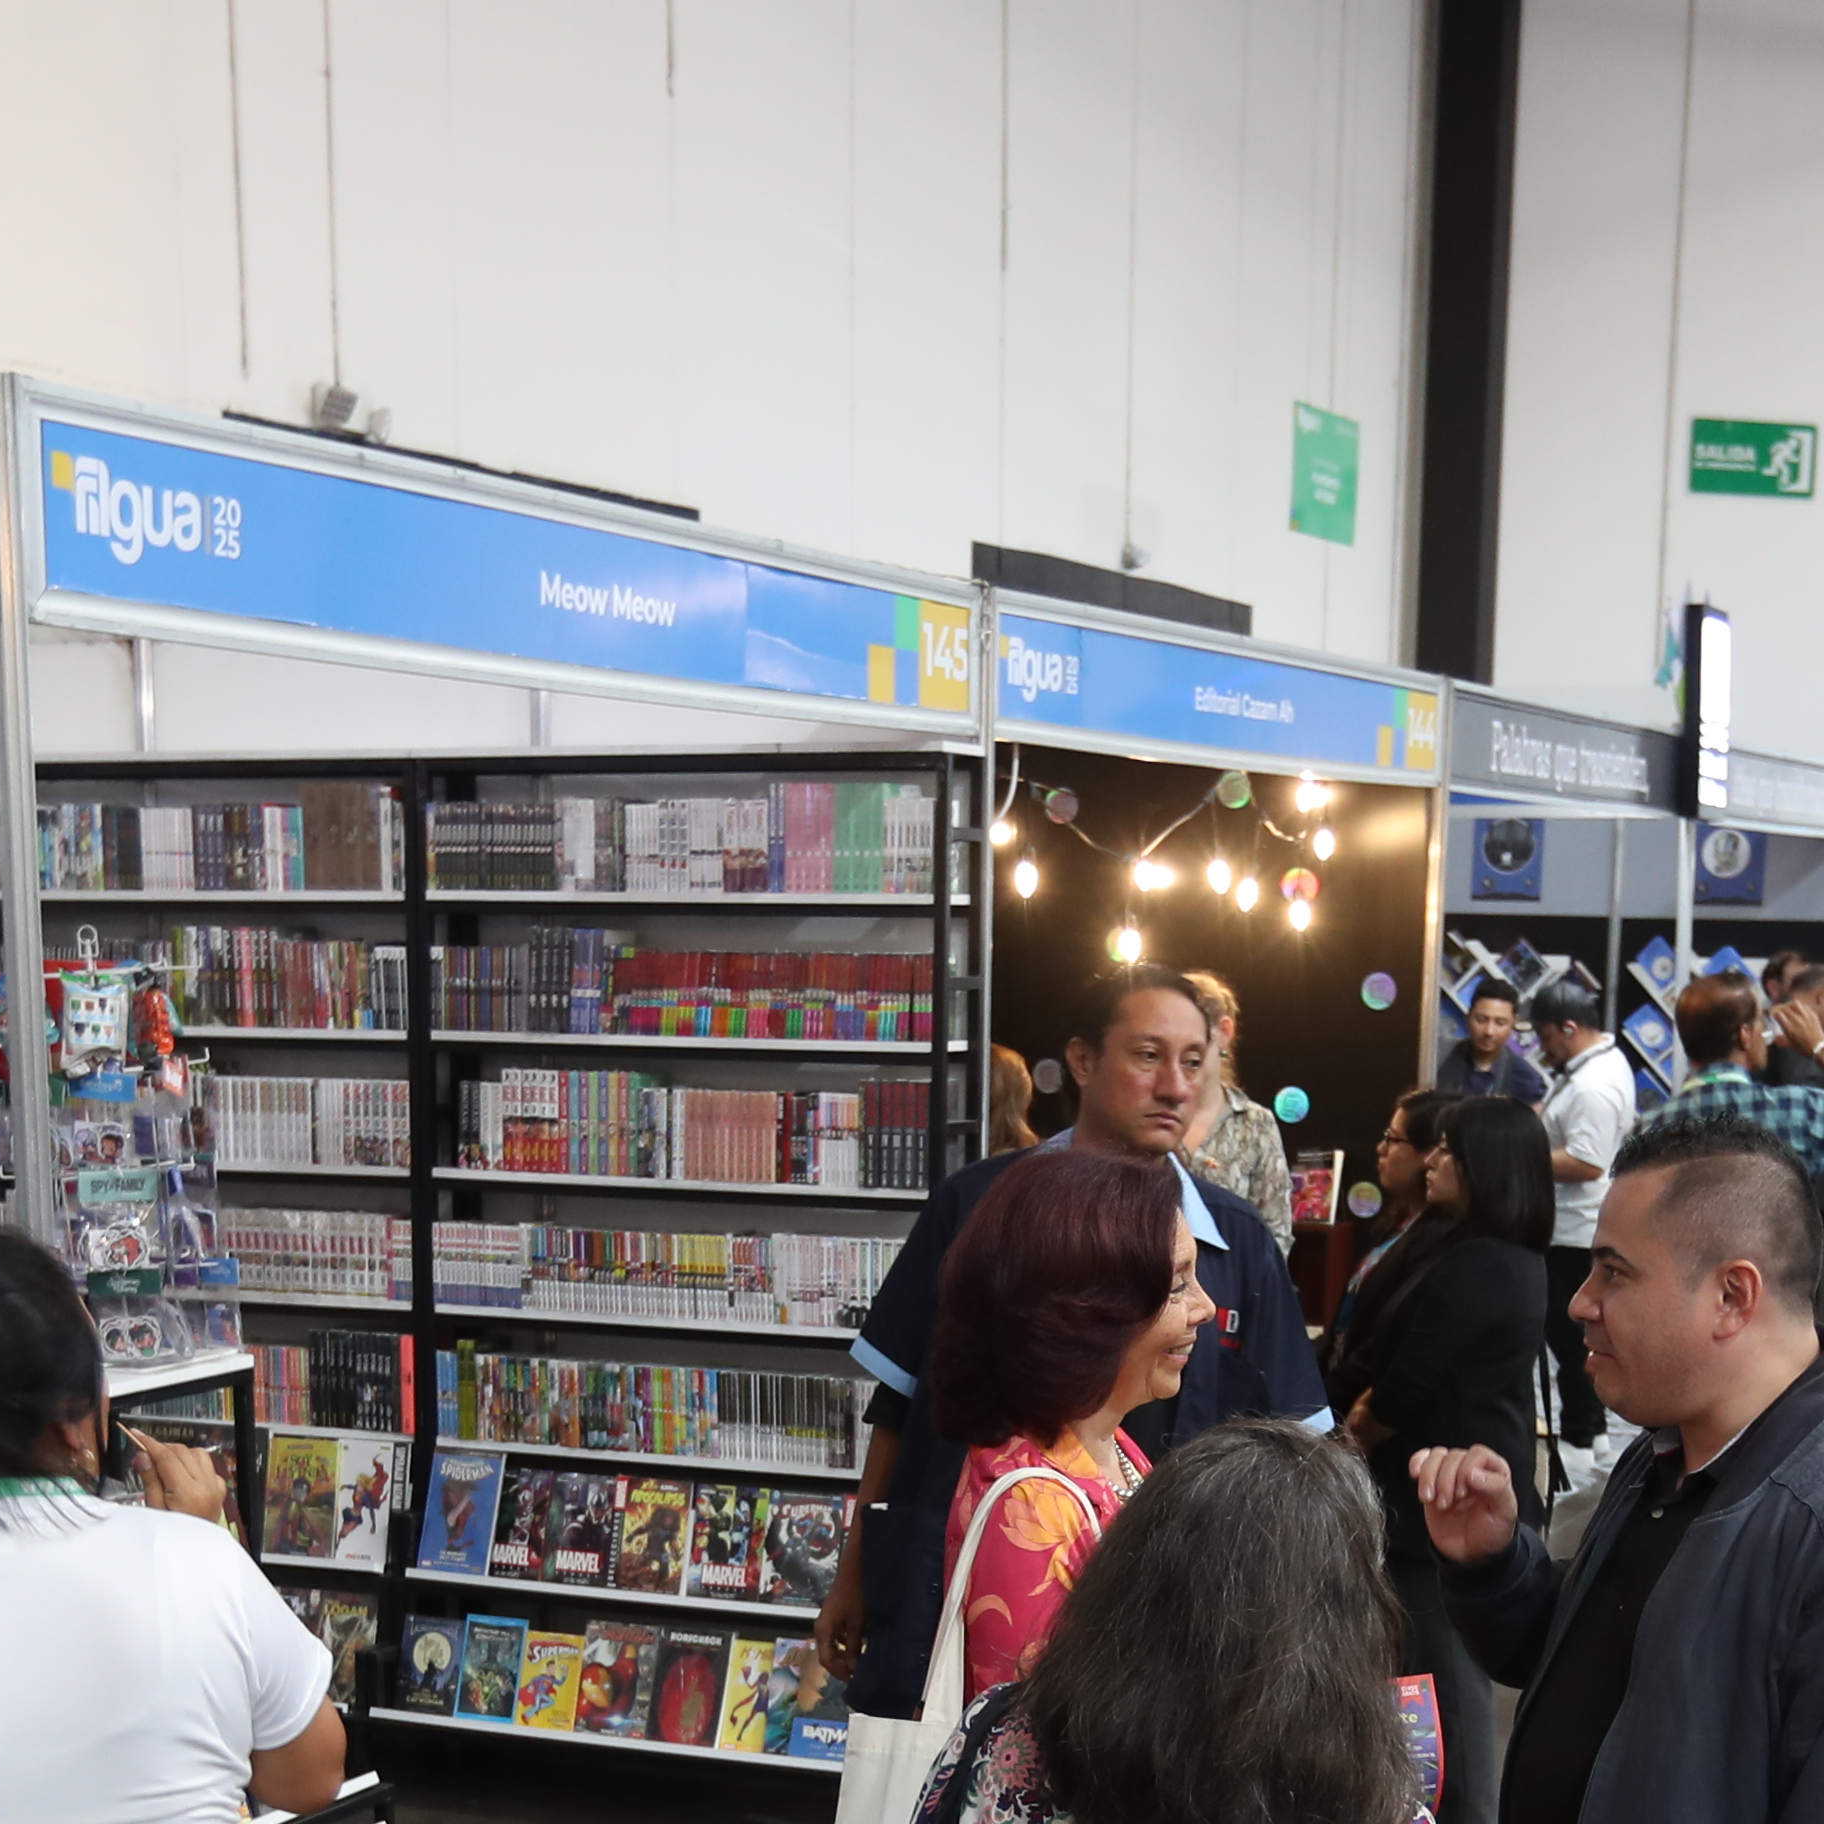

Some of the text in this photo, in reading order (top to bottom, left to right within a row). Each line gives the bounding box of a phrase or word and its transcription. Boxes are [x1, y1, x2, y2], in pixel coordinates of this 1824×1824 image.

[213, 495, 243, 529] 20
[213, 528, 243, 560] 25
[539, 570, 676, 629] Meow Meow
[922, 621, 969, 685] 145
[1194, 686, 1242, 717] Editorial
[1407, 707, 1436, 752] 144
[1490, 719, 1552, 780] Palabras
[1554, 740, 1578, 793] que
[439, 1461, 495, 1482] SPIDERMAN
[782, 1503, 833, 1517] SUPERMAN
[555, 1549, 601, 1573] MARVEL
[701, 1563, 747, 1587] MARVEL
[324, 1601, 369, 1617] LOGAN
[531, 1645, 580, 1664] SUPERMAN
